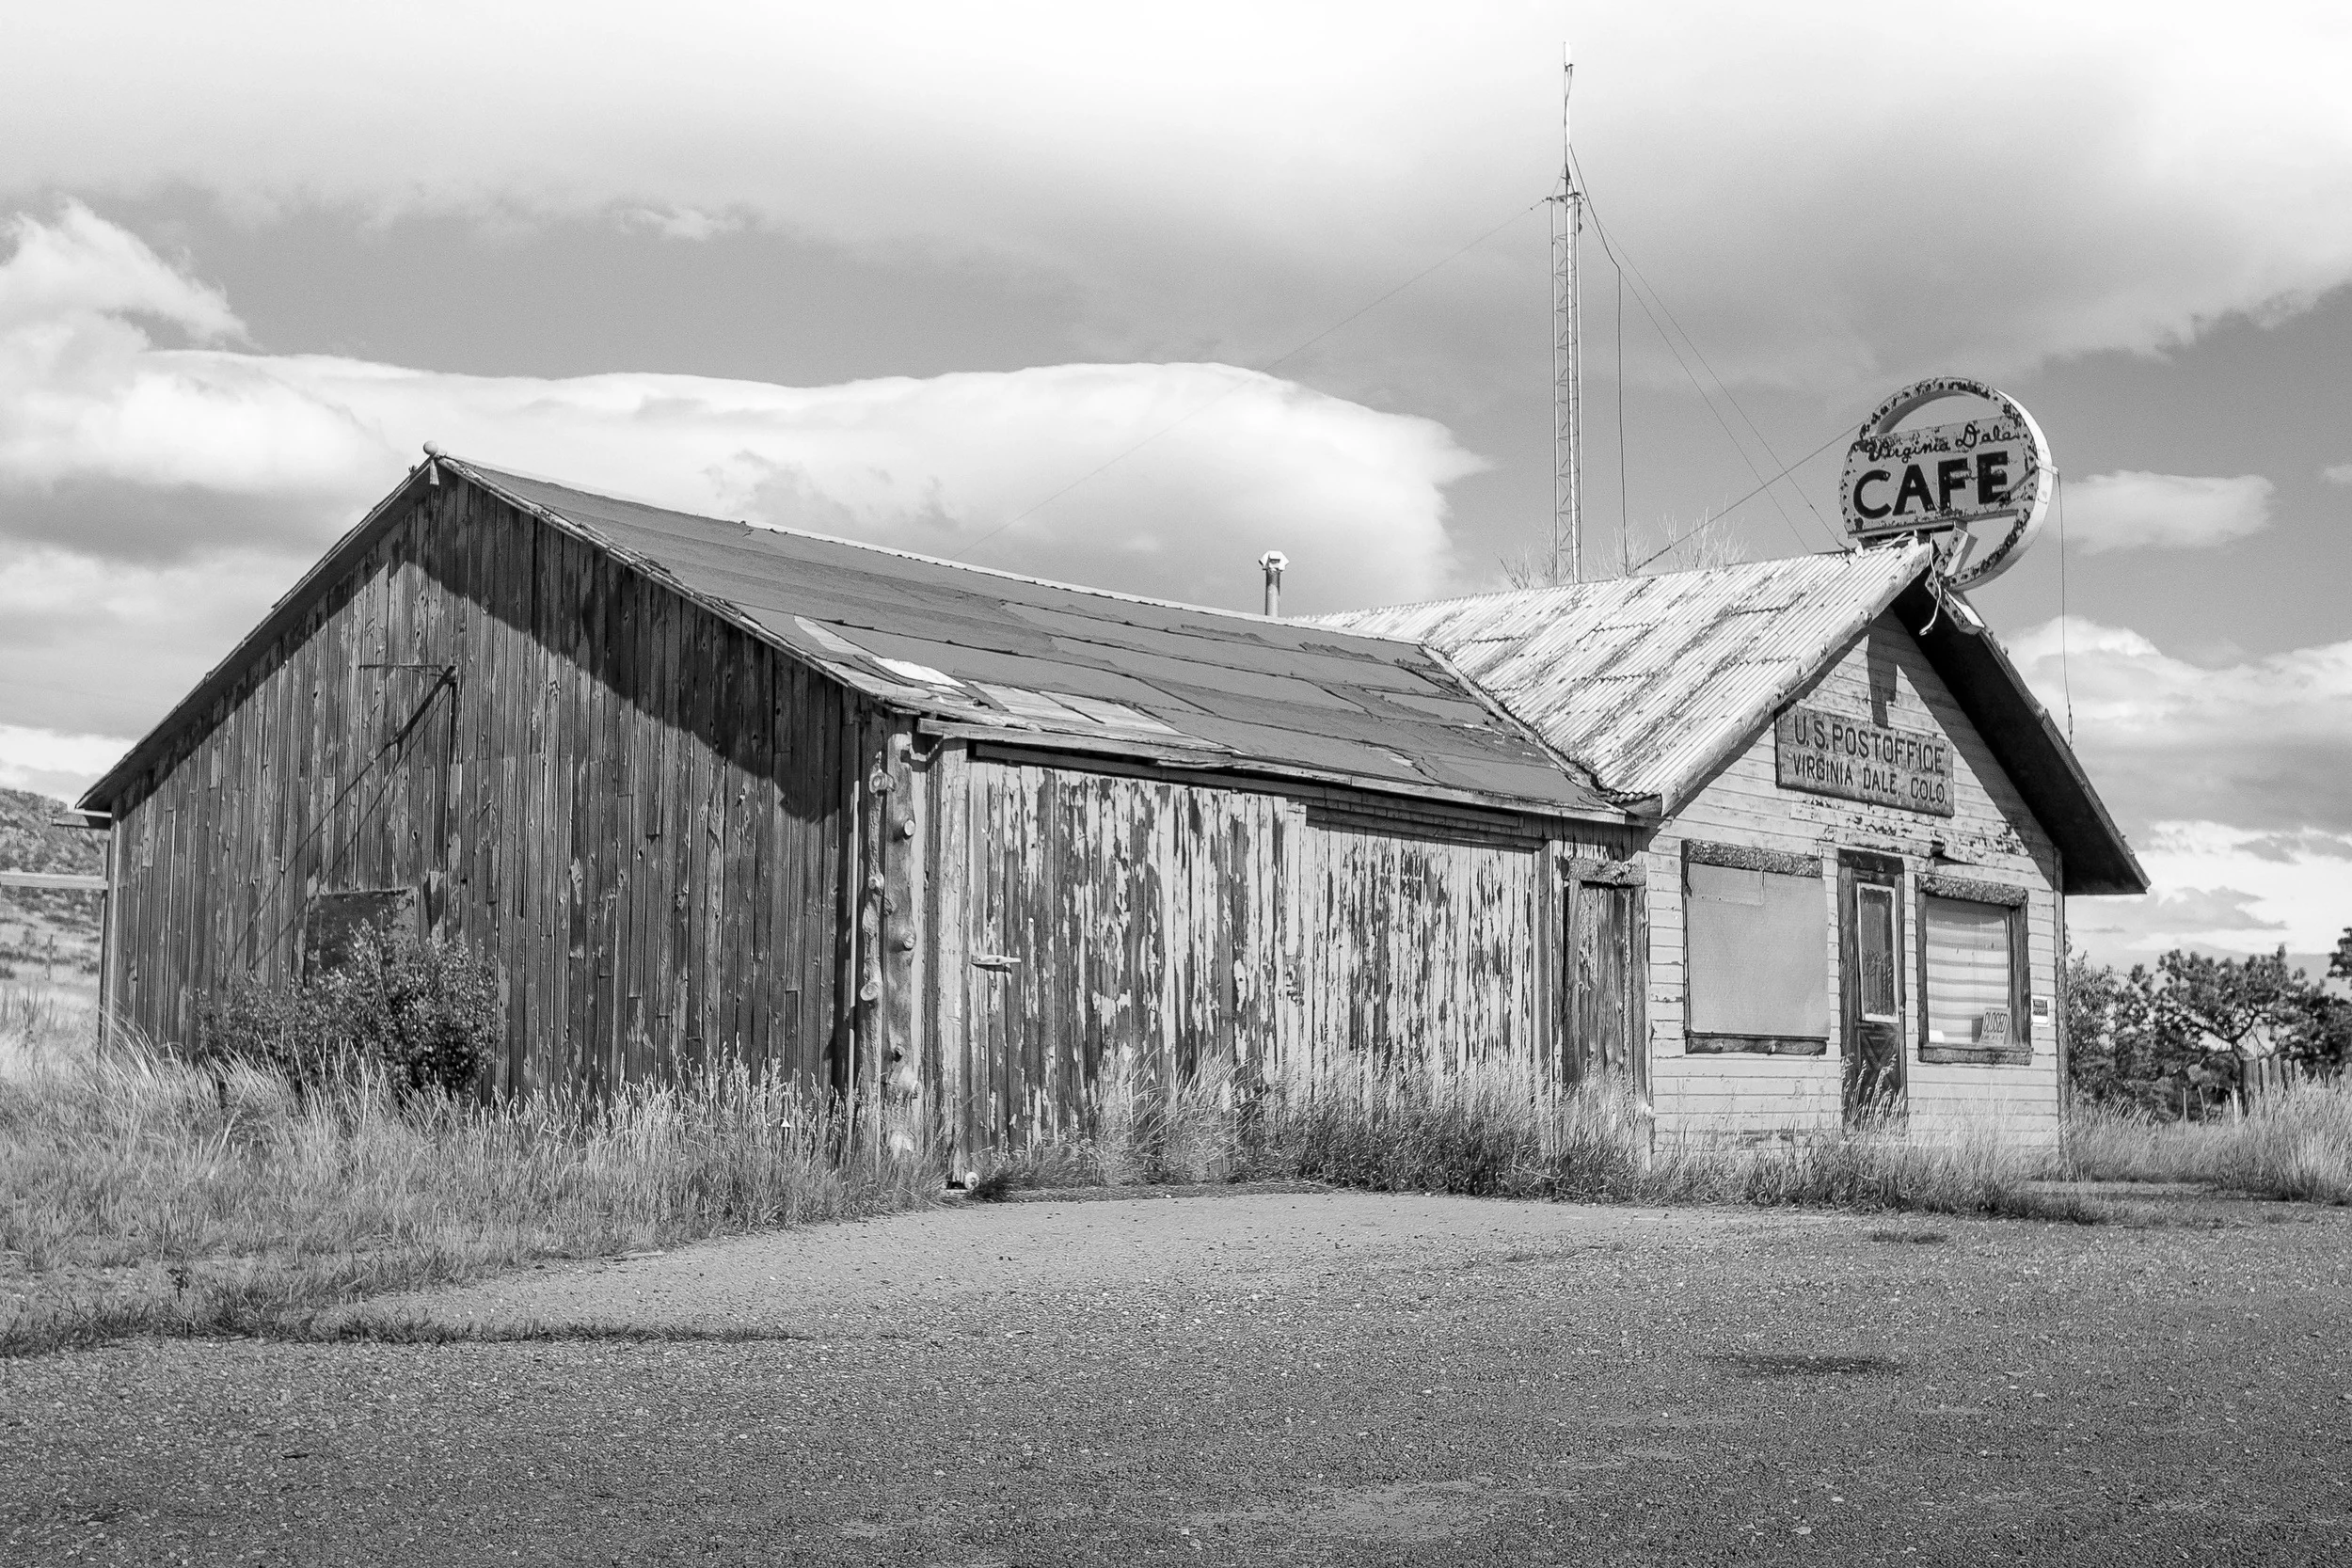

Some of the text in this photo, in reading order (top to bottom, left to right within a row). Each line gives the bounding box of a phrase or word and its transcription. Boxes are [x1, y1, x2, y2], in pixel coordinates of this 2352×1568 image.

[1853, 451, 2009, 518] CAFE
[1793, 752, 1947, 805] VIRGINIA DALE, COLO.
[1982, 1011, 2009, 1033] CLOSED
